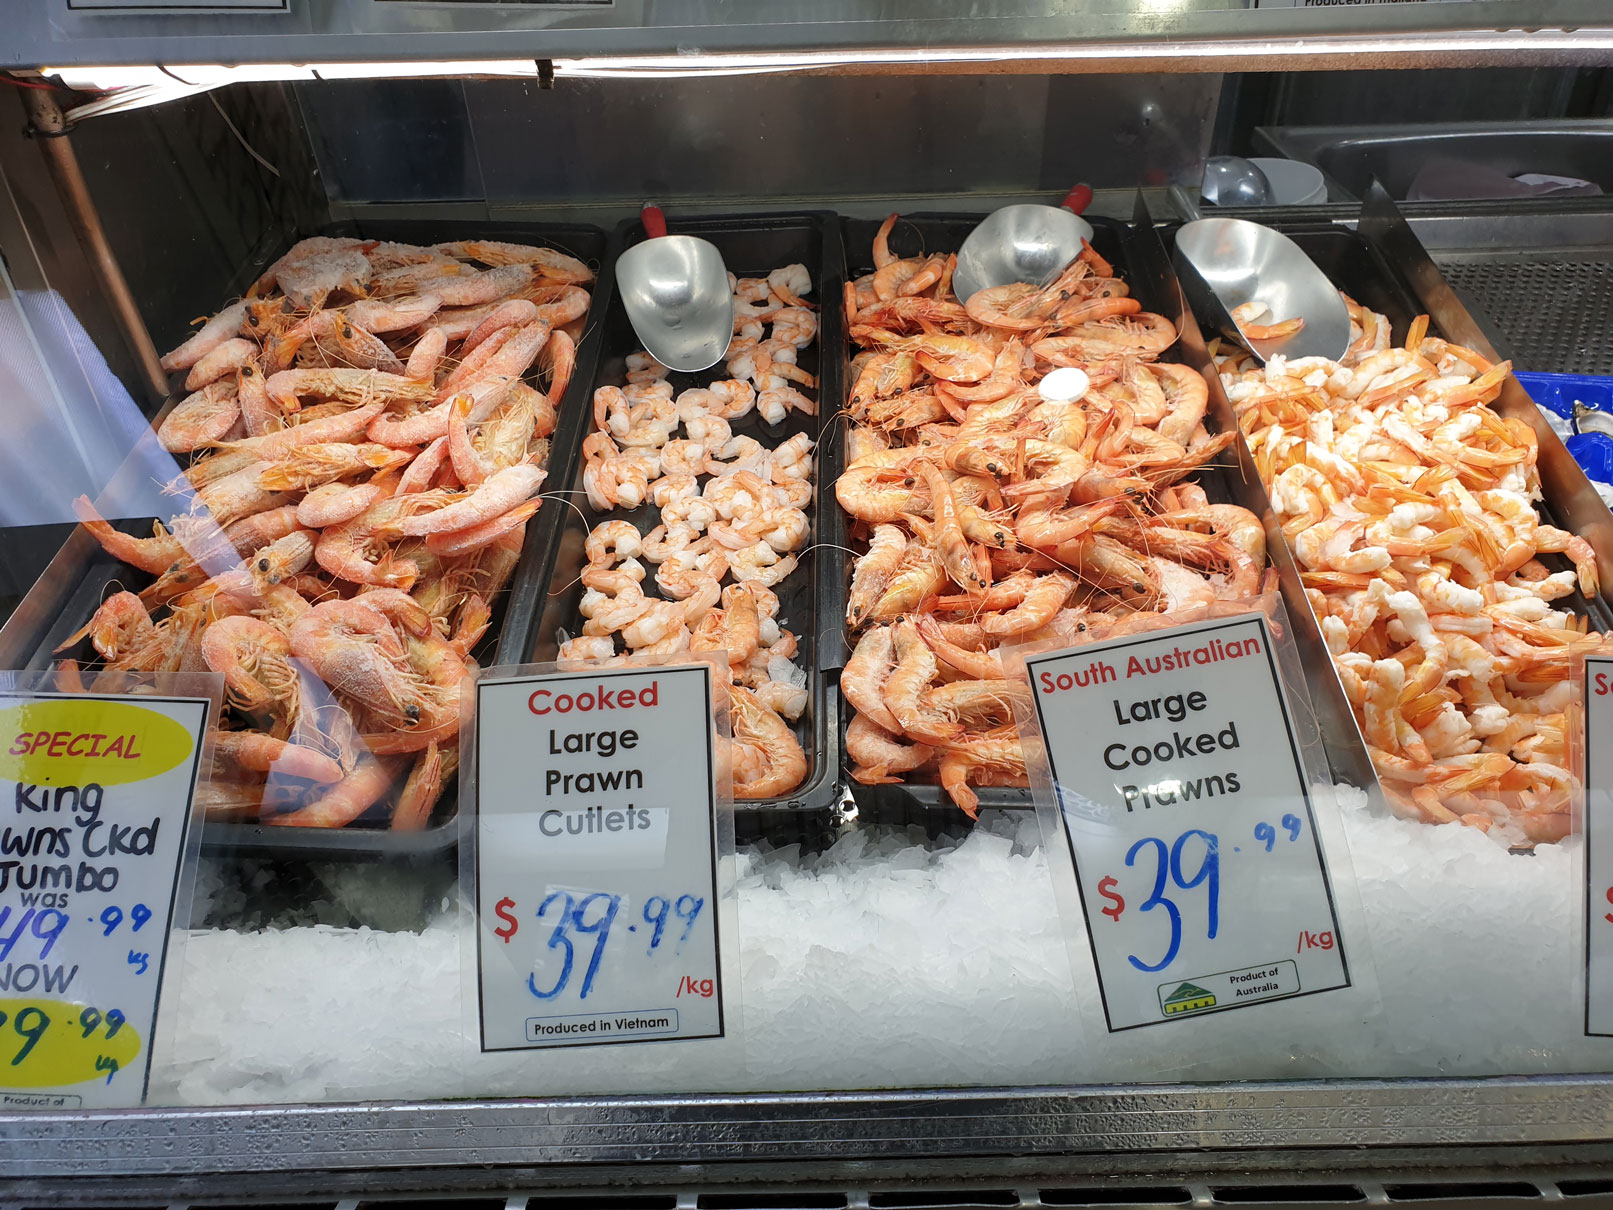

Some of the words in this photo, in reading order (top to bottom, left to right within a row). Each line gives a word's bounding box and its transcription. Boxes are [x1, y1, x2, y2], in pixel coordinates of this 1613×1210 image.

[1039, 661, 1117, 694] South
[1126, 638, 1261, 679] Australian
[528, 681, 659, 715] Cooked
[1595, 673, 1613, 696] S
[1113, 691, 1207, 726] Large
[9, 731, 141, 759] SPECIAL
[549, 729, 639, 757] Large
[1103, 722, 1240, 770] Cooked
[546, 768, 643, 796] Prawn
[1122, 772, 1241, 812] Prawns
[538, 804, 651, 837] Cutlets
[21, 892, 69, 908] was
[1297, 931, 1334, 954] /kg
[676, 976, 714, 998] /kg
[1230, 971, 1267, 984] Product
[1269, 967, 1278, 976] of
[1236, 982, 1279, 997] Australia
[535, 1020, 596, 1035] Produced
[600, 1020, 611, 1031] in
[615, 1018, 669, 1030] Vietnam
[3, 1096, 50, 1106] Product
